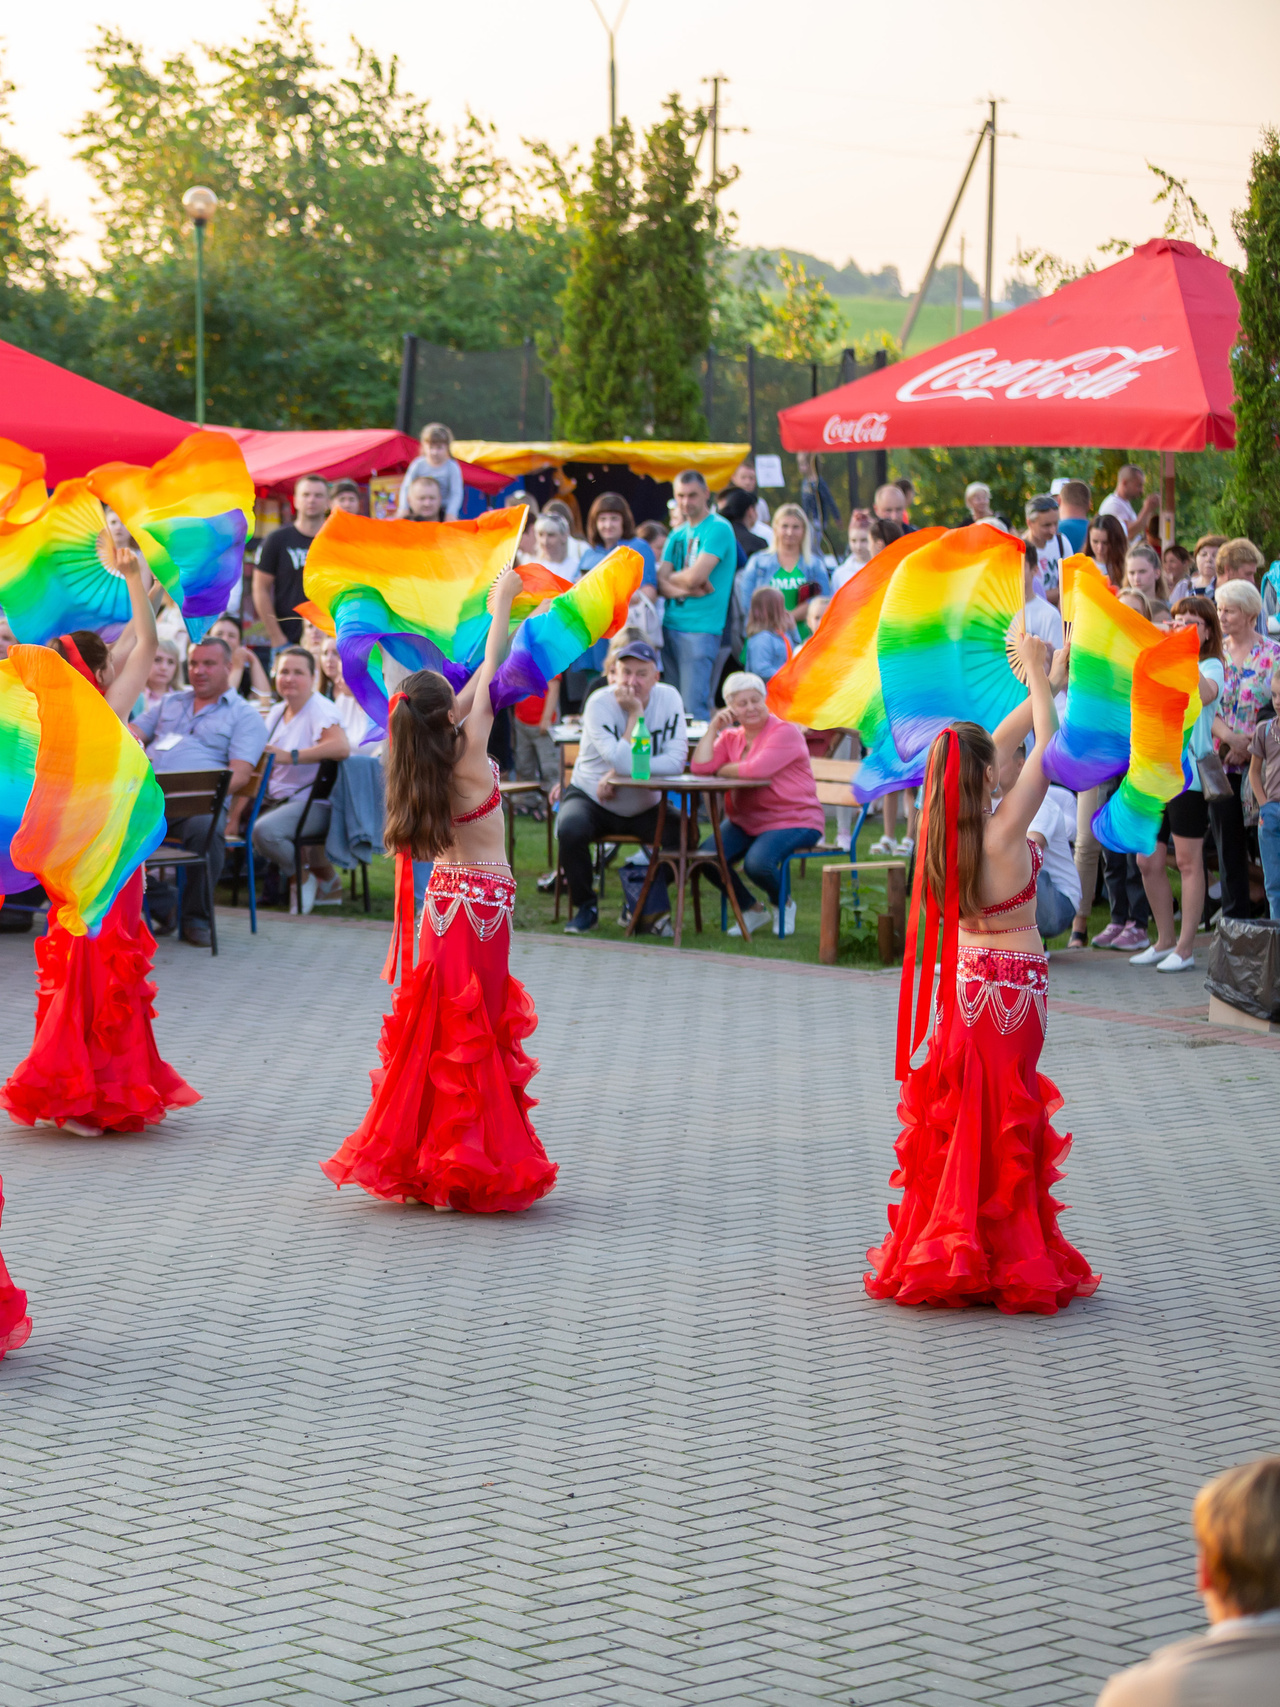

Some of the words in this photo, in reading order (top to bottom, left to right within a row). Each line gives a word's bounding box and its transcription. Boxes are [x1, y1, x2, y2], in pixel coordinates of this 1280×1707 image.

[895, 345, 1180, 402] Coca-Cola
[823, 412, 892, 445] Coca-Cola
[602, 713, 679, 757] YTH
